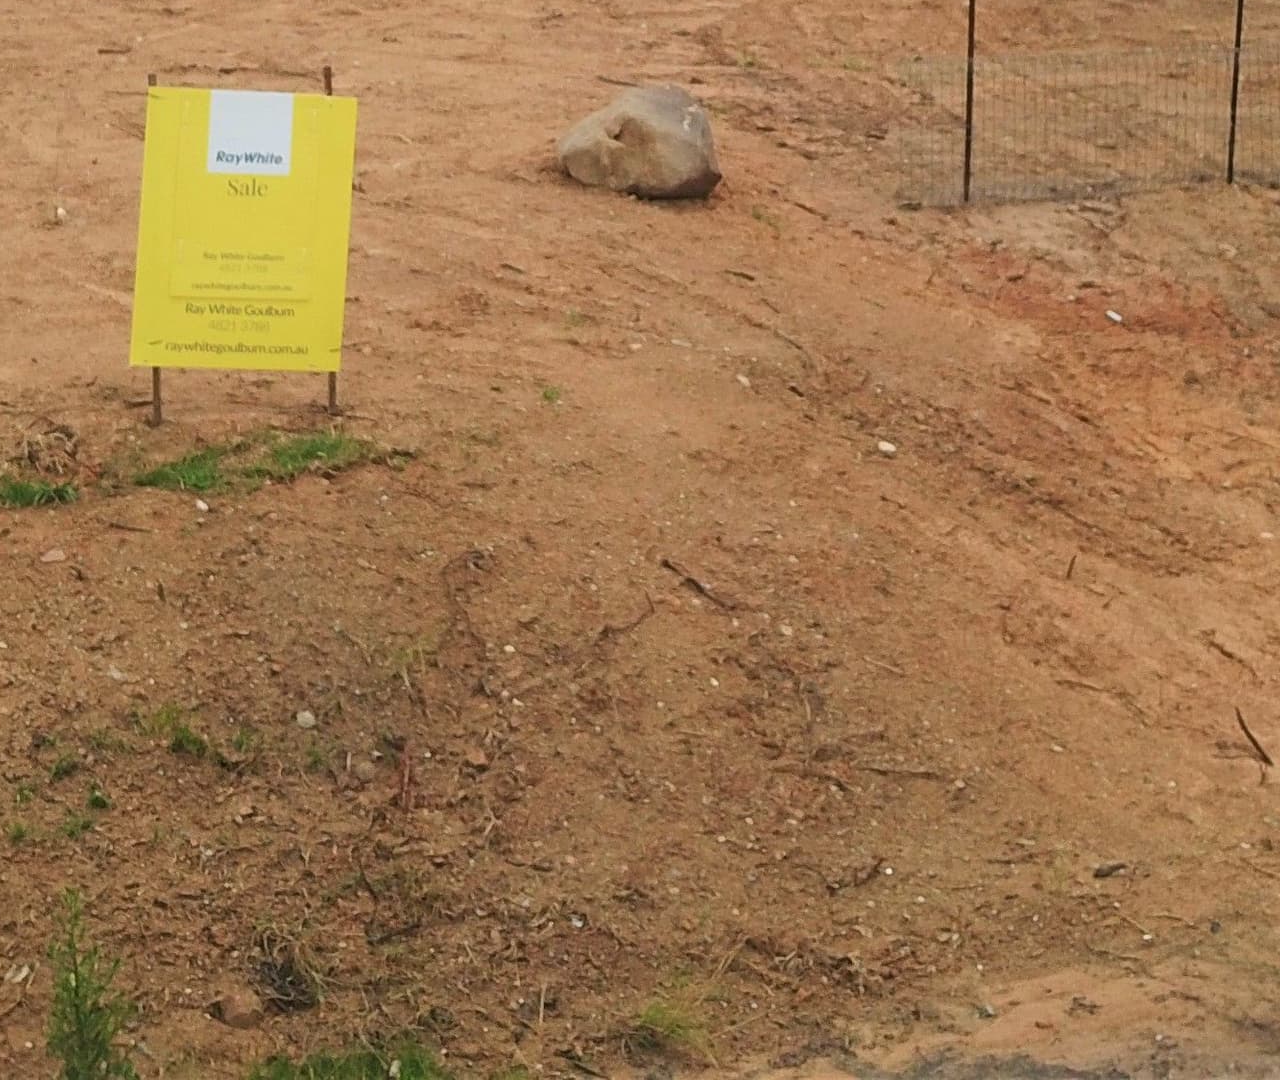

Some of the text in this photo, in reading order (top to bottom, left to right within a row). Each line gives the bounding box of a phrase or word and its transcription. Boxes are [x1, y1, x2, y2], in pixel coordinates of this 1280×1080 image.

[227, 178, 269, 197] Sale
[185, 302, 295, 317] Ray White Goulburn
[165, 340, 309, 356] raywhitegoulburn.com.au
